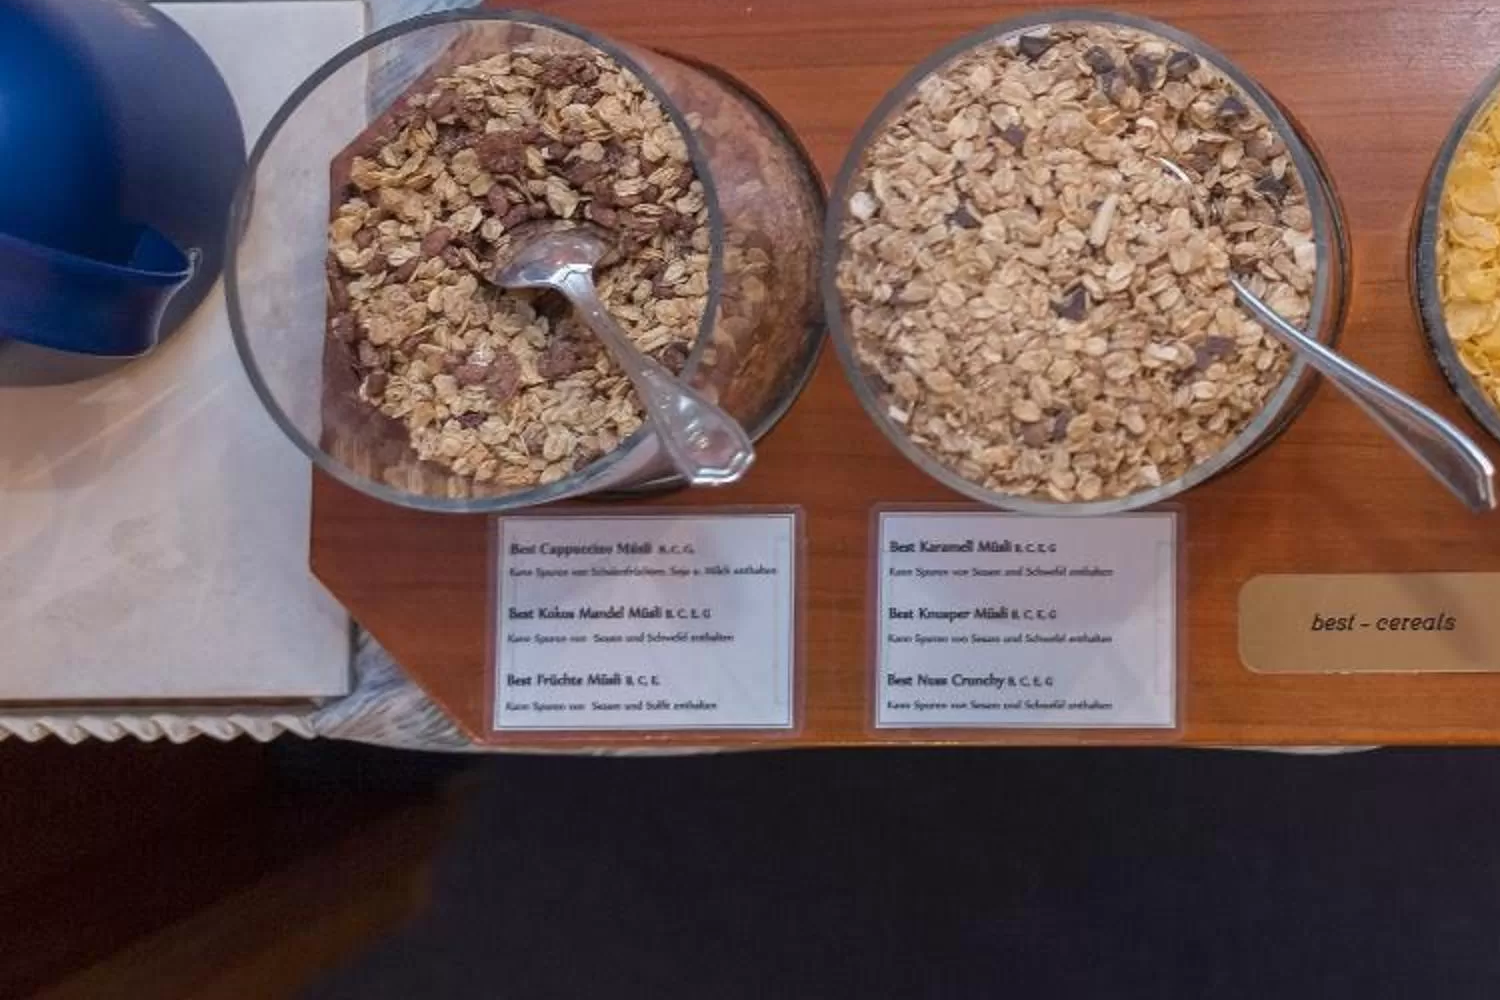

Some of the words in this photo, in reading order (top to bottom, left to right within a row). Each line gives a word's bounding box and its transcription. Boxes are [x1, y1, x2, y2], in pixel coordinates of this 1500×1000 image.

[510, 543, 536, 555] Best
[890, 540, 914, 552] Best
[509, 608, 534, 619] Best
[889, 608, 914, 619] Best
[1311, 613, 1357, 631] best
[1375, 612, 1457, 632] cereals
[508, 674, 532, 686] Best
[887, 674, 912, 686] Best
